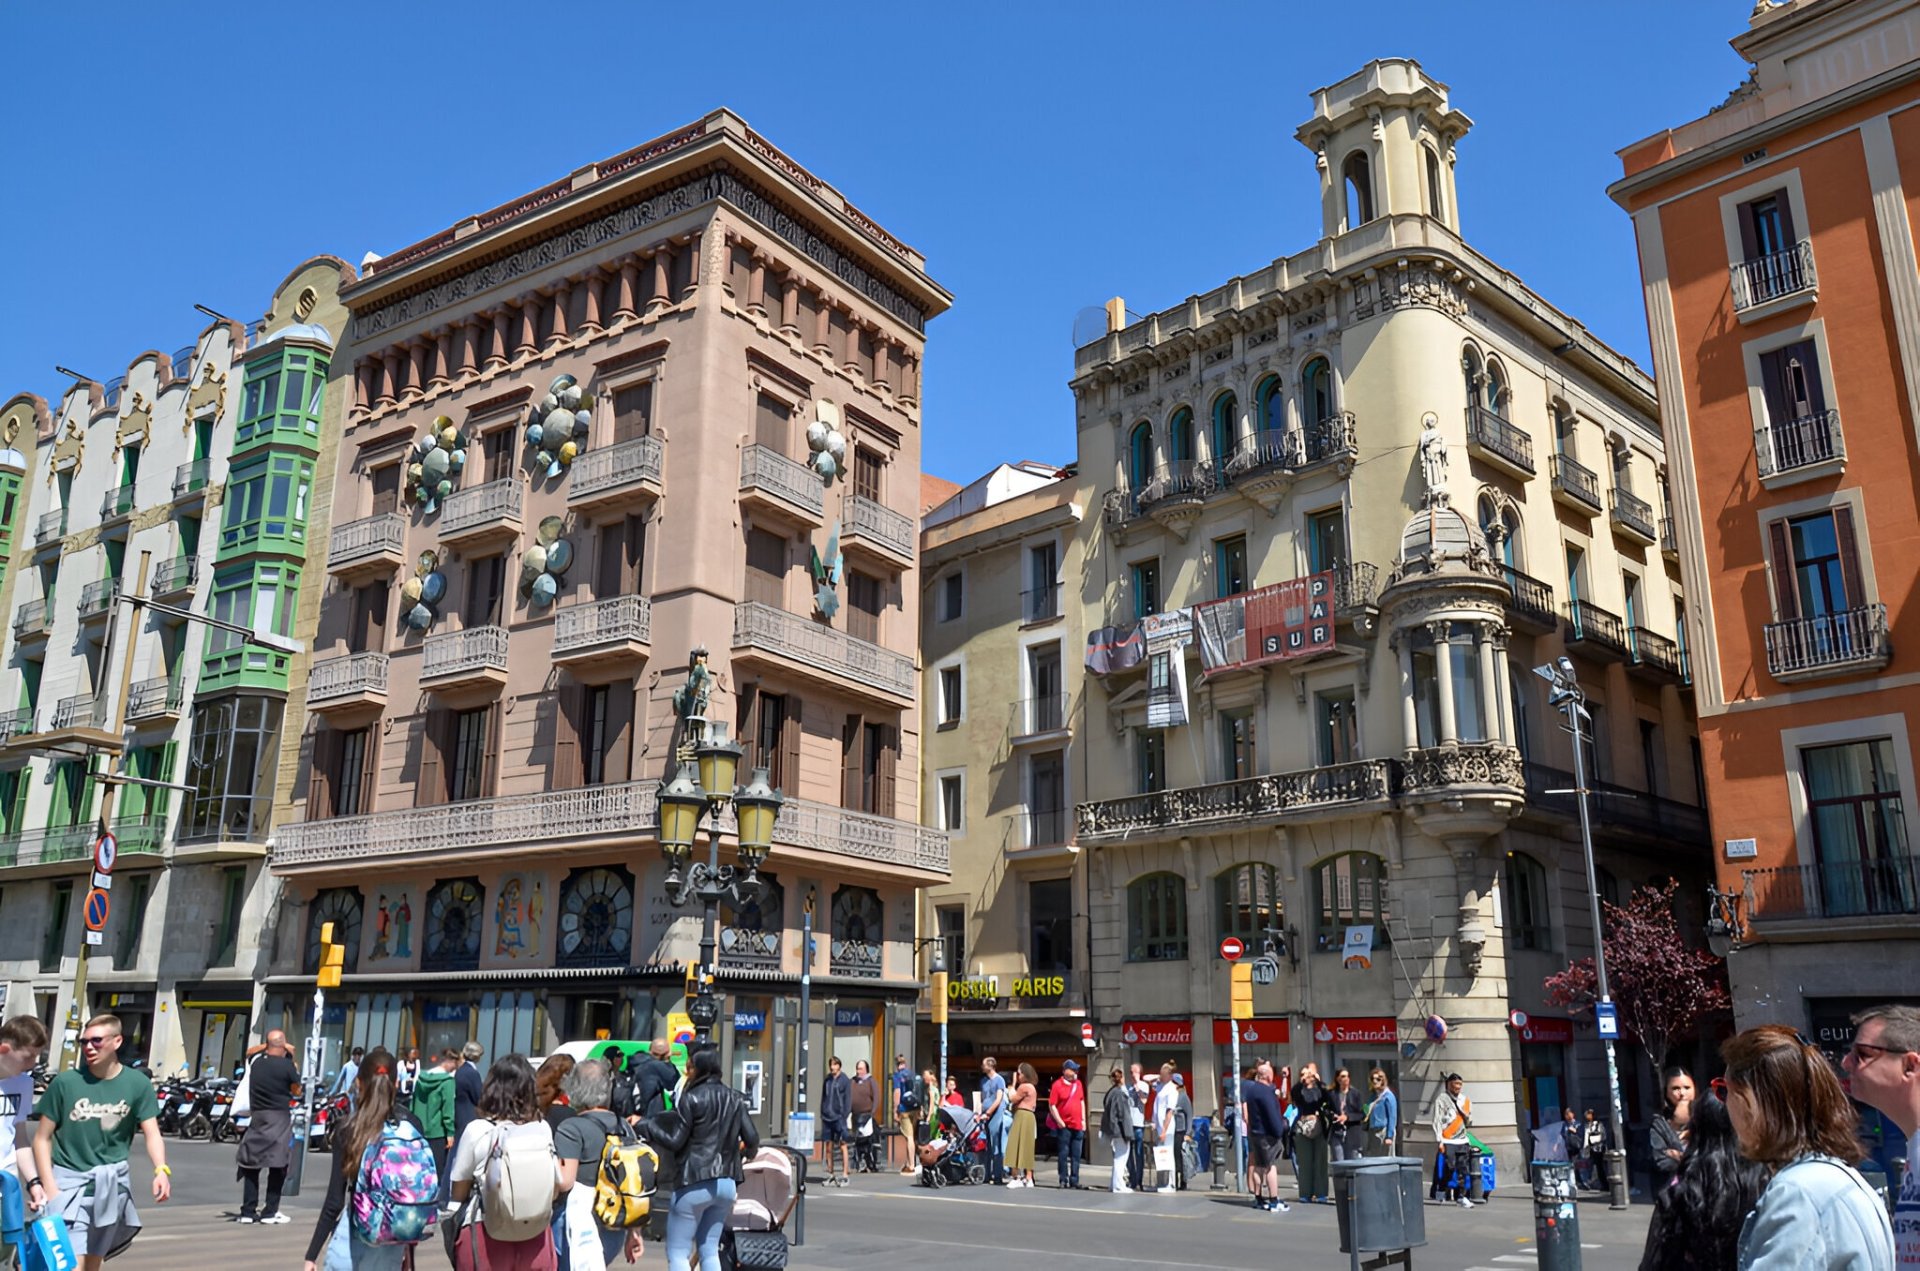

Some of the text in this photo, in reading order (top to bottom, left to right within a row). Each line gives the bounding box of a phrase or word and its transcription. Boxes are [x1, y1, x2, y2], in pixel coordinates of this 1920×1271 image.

[1012, 976, 1064, 998] PARIS
[734, 1013, 759, 1026] BBVA
[1140, 1028, 1190, 1043] Santander
[1820, 1027, 1853, 1041] eur
